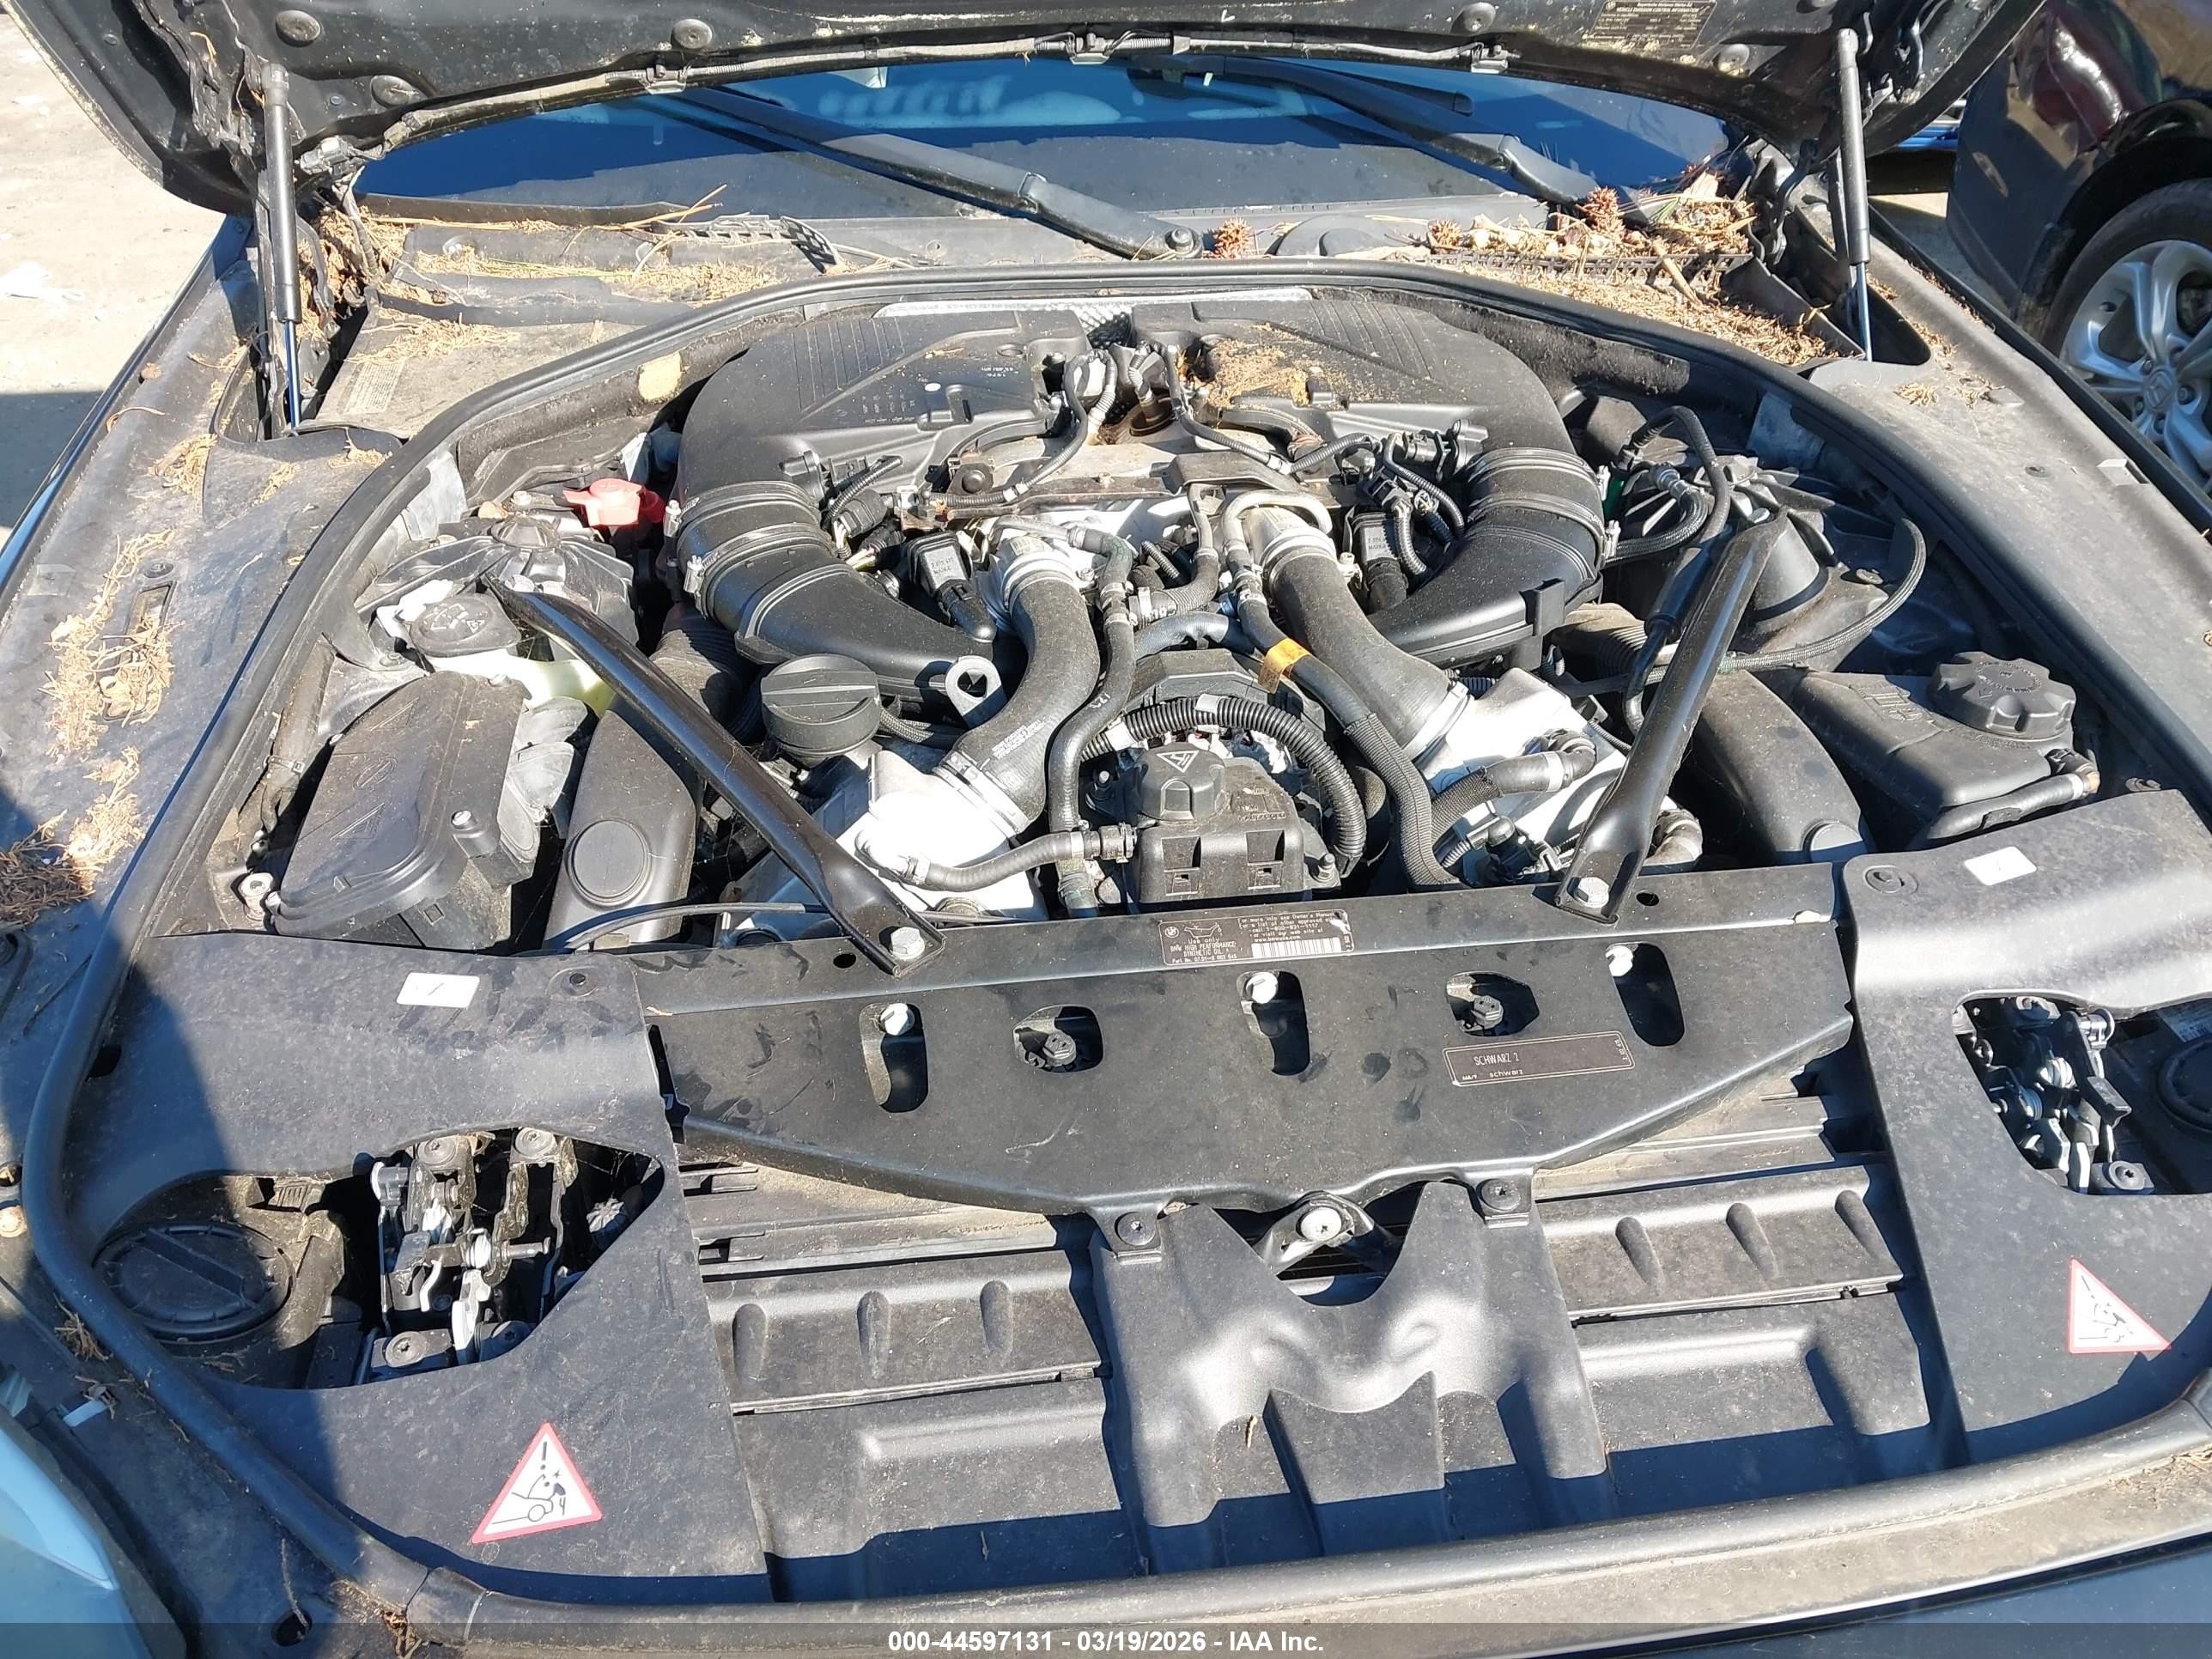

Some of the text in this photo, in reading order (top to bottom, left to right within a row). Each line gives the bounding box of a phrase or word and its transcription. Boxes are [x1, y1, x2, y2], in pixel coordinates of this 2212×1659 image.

[1183, 948, 1212, 957] SYNTHETIC
[1474, 1052, 1520, 1066] SCHWARZ 2
[1489, 1067, 1524, 1079] schwarz
